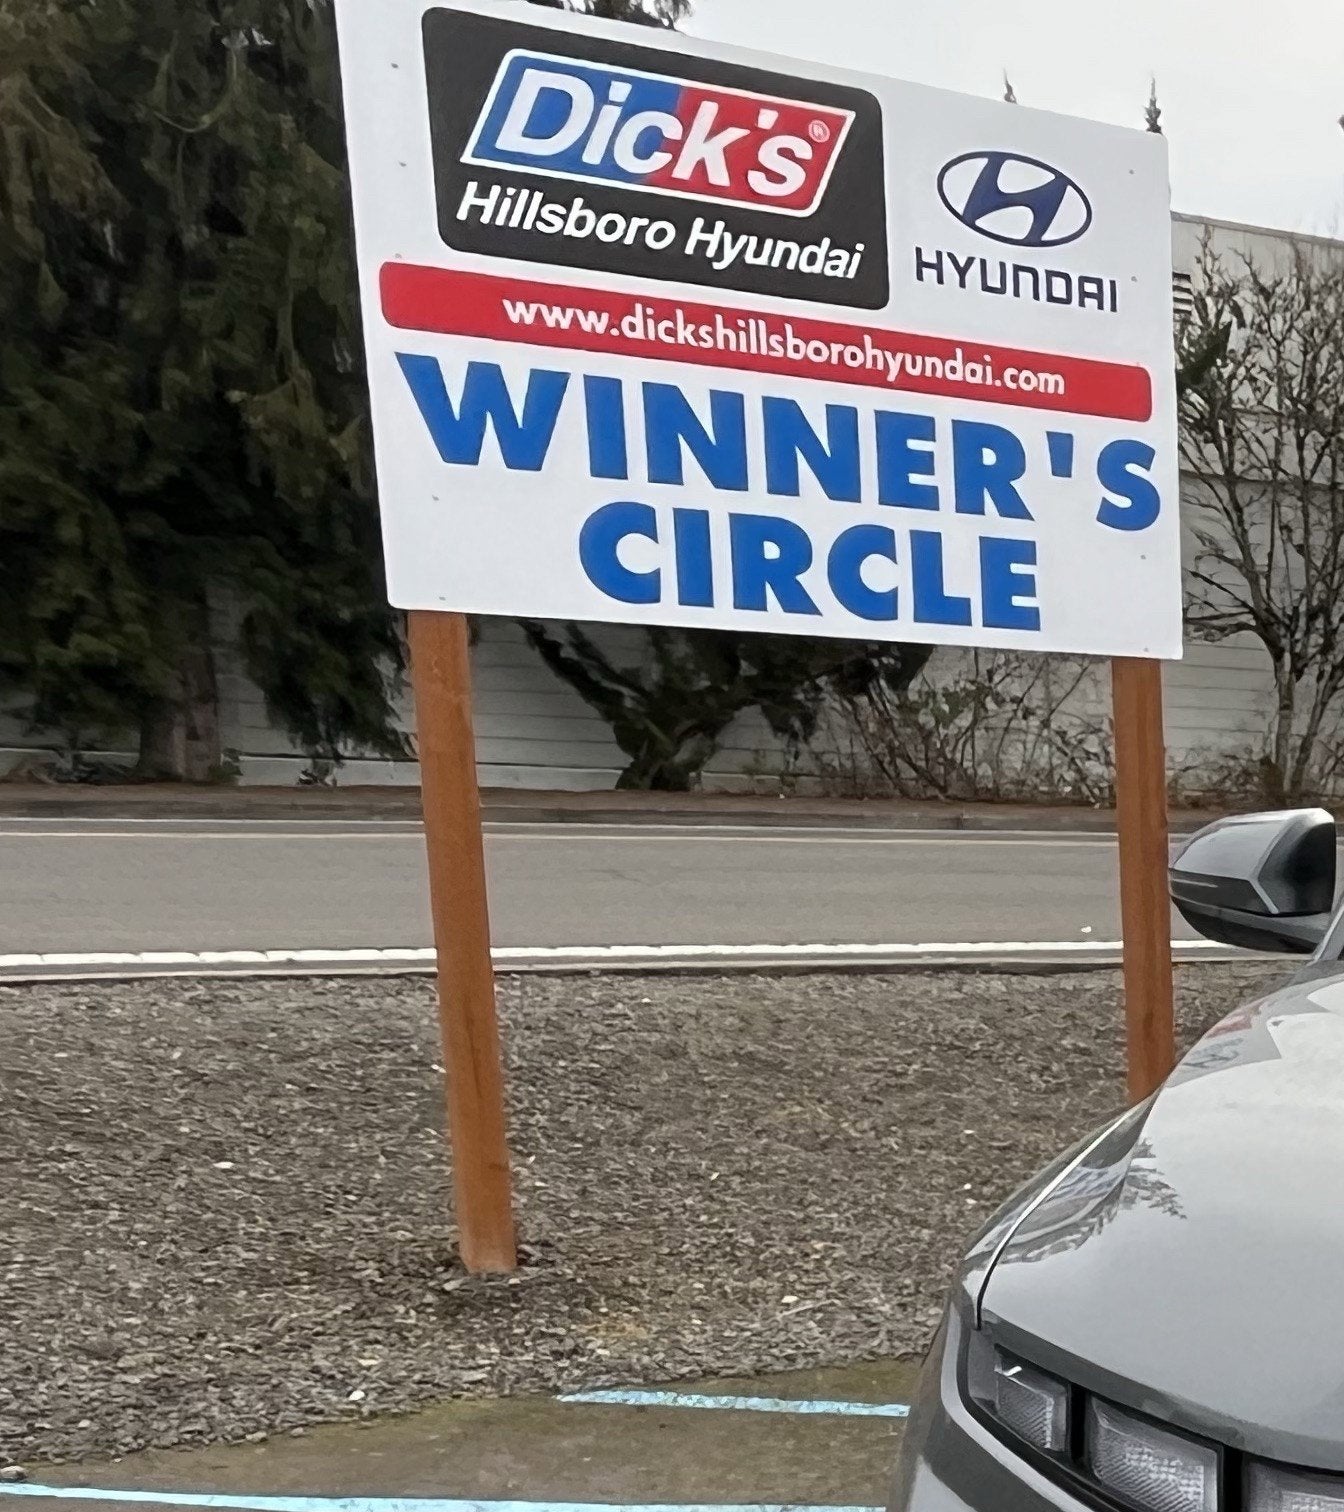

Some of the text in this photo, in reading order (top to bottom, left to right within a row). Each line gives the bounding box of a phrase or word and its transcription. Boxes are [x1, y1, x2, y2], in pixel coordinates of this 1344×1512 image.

[492, 66, 815, 198] Dick's
[456, 181, 866, 281] Hillsboro Hyundai
[914, 246, 1119, 313] HYUNDAI
[502, 294, 1066, 398] www.dickshillsborohyundai.com
[394, 352, 1162, 532] WINNER'S
[578, 501, 1042, 632] CIRCLE
